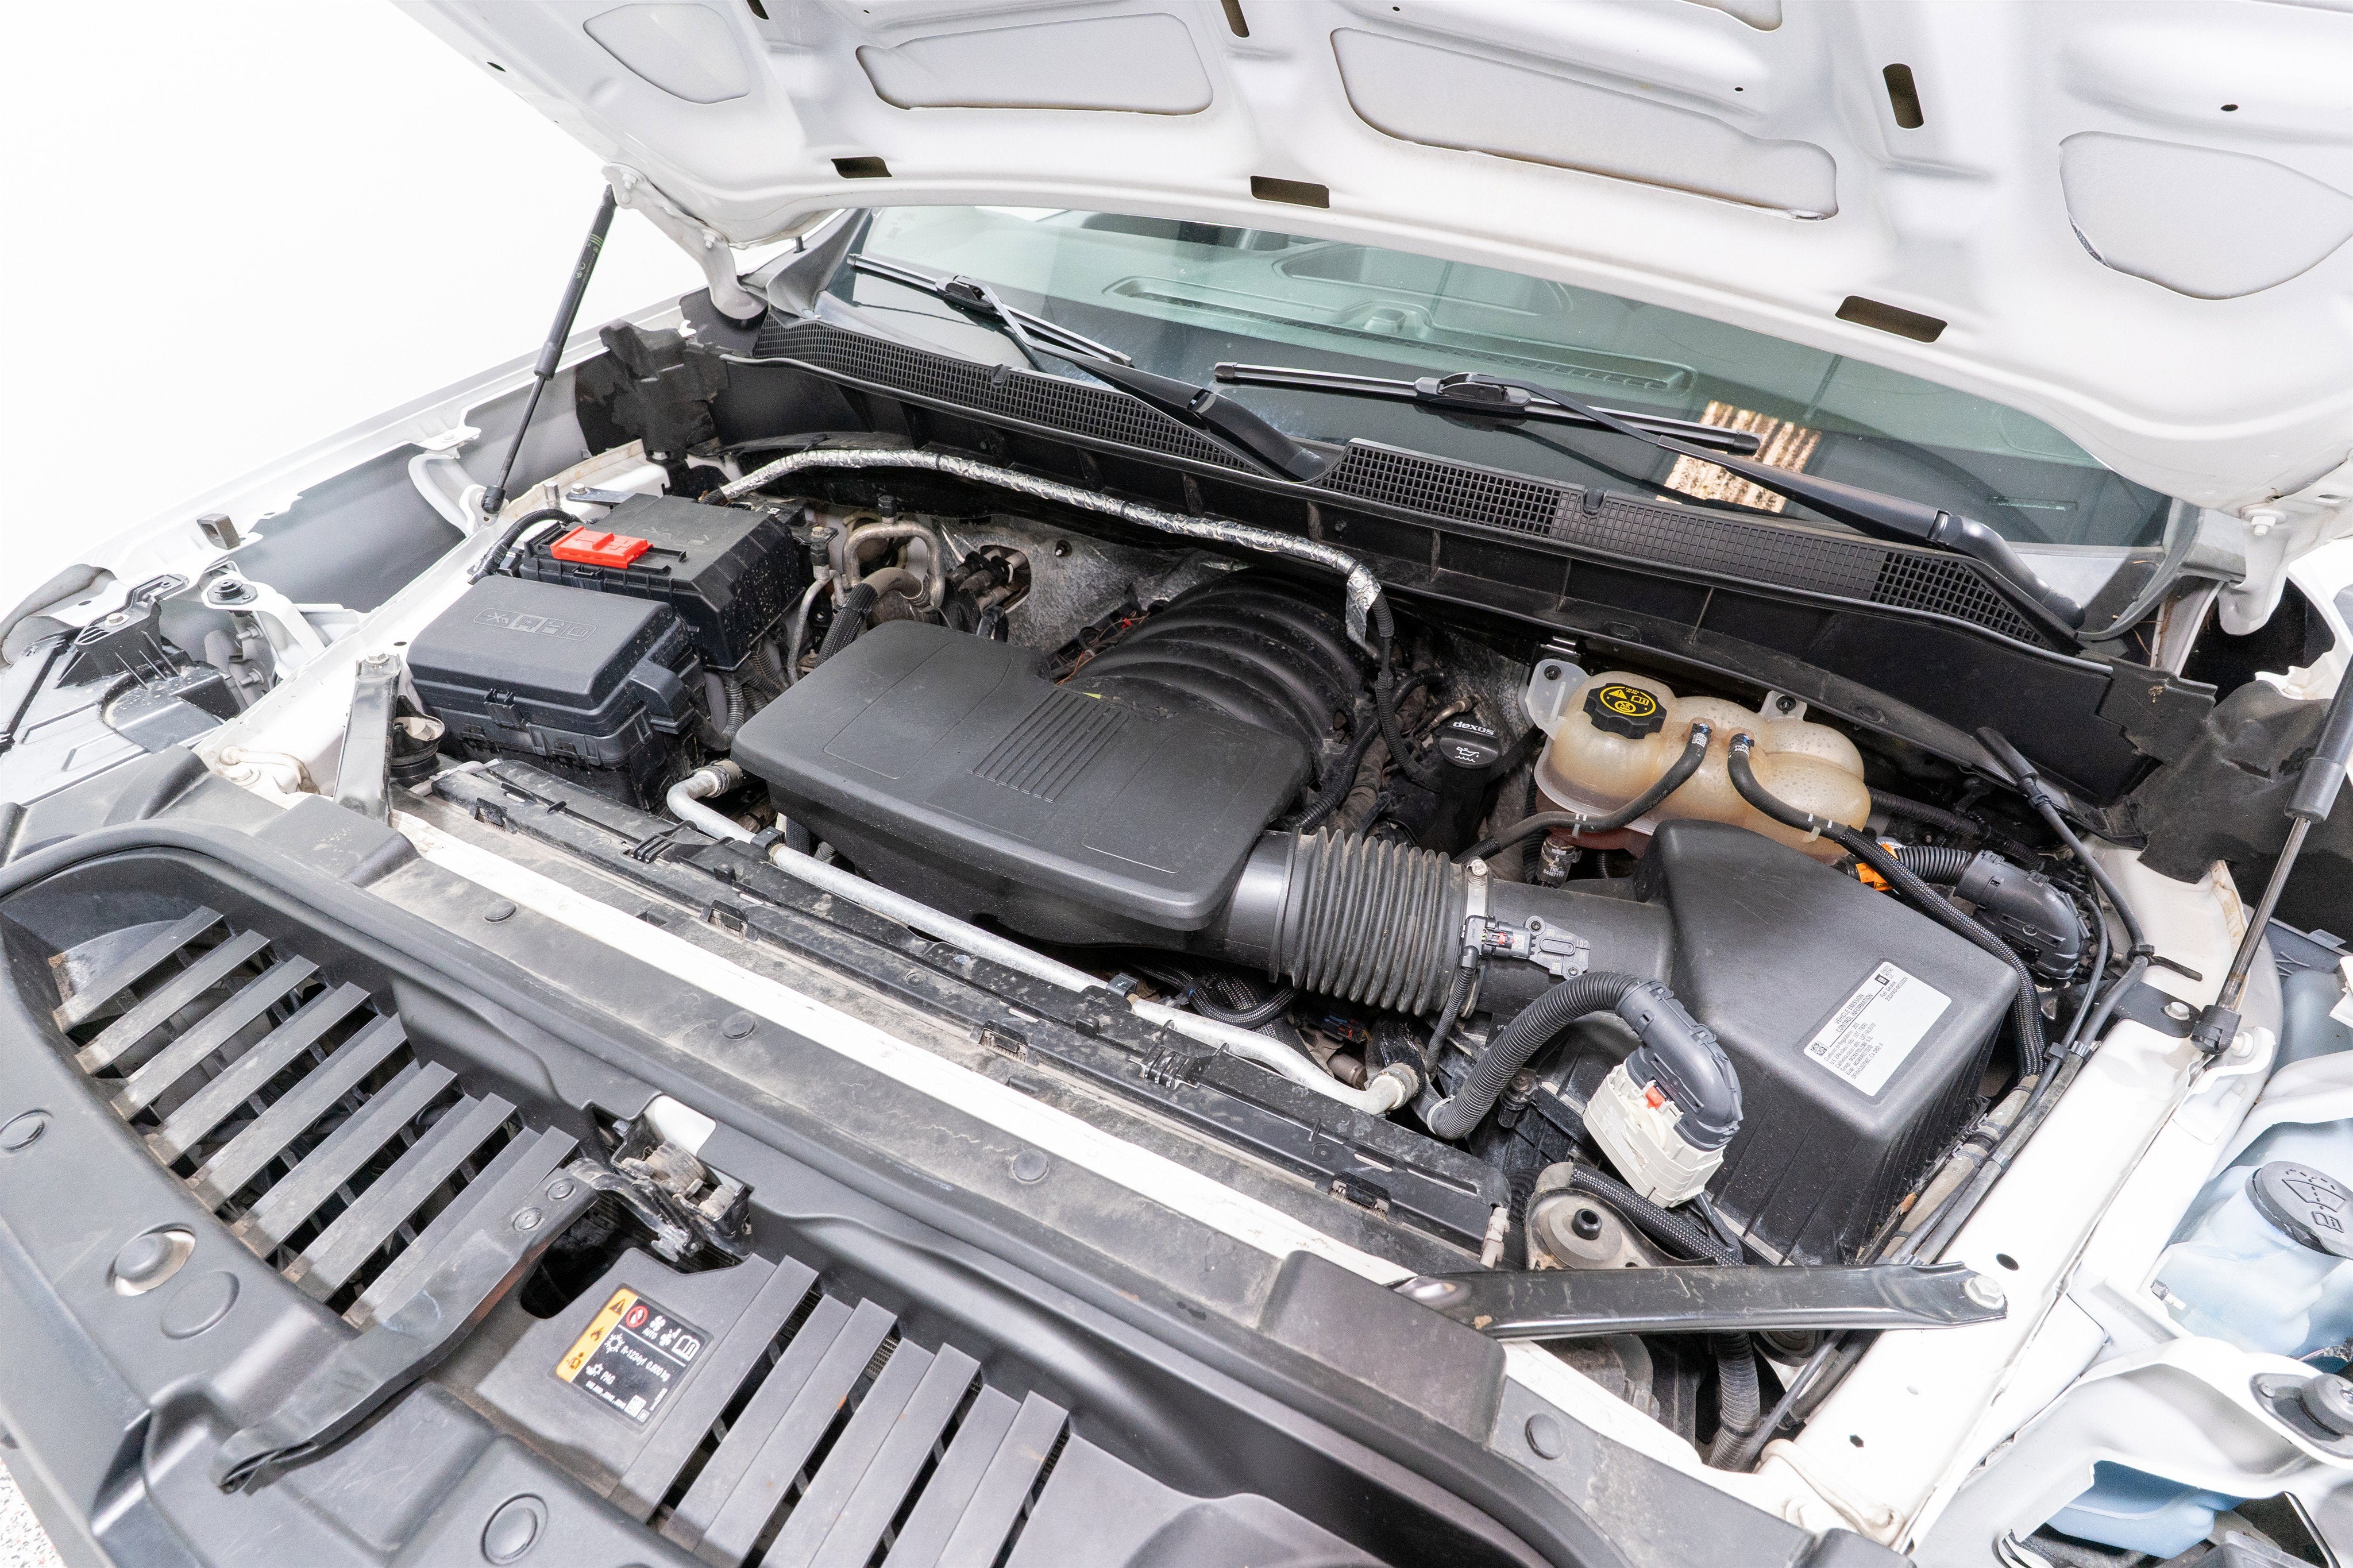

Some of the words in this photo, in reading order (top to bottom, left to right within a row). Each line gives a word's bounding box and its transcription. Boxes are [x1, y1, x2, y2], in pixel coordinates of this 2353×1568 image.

[1453, 721, 1496, 735] dexos
[1834, 1009, 1850, 1024] VEHICLE
[1847, 993, 1864, 1010] EMISSION
[1836, 1015, 1854, 1032] CONTROL
[1850, 993, 1873, 1016] INFORMATION
[1824, 1047, 1838, 1061] Conforms
[1835, 1054, 1848, 1068] California
[1846, 1047, 1854, 1055] class
[642, 1328, 657, 1339] AUTO
[620, 1345, 647, 1366] R-1234yf
[661, 1370, 671, 1382] kg
[600, 1371, 616, 1385] PAG
